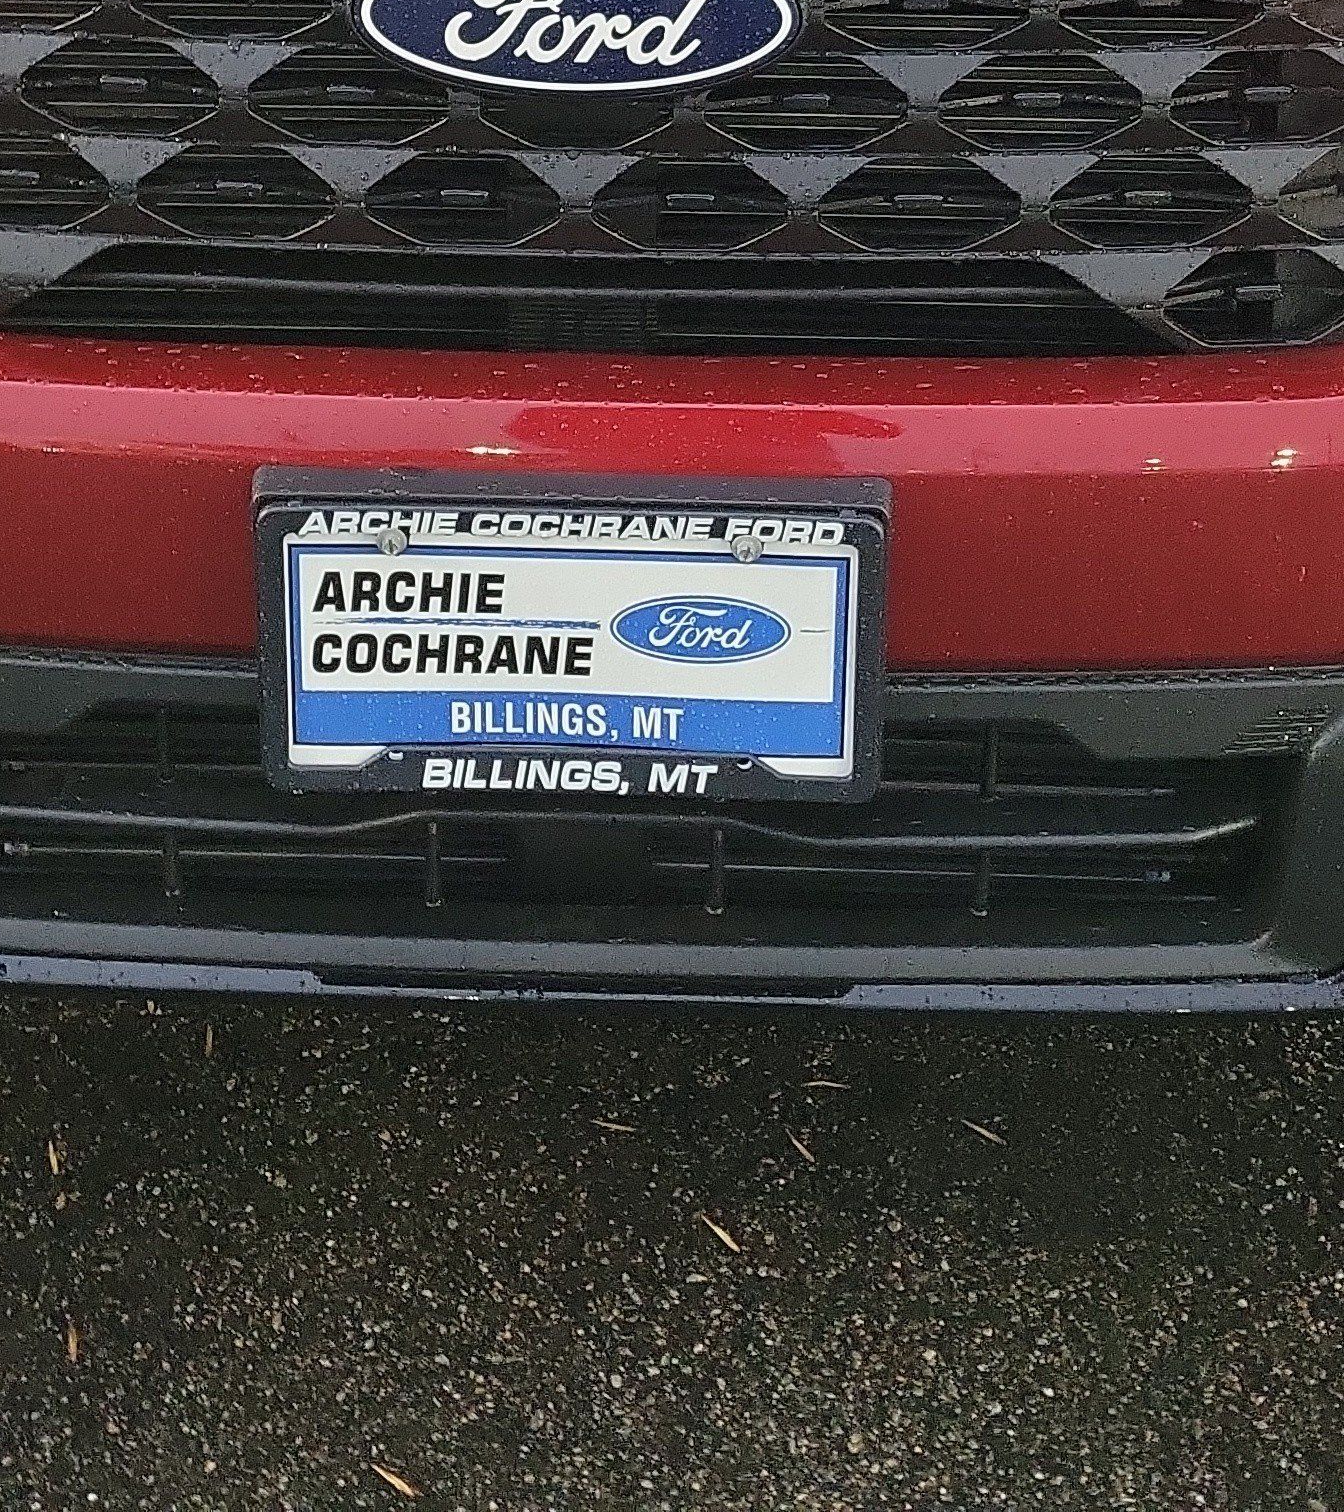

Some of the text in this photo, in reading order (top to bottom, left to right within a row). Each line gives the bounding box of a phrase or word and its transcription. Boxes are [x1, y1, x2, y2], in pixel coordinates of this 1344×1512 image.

[298, 510, 845, 546] ARCHIE COCHRANE FORD
[312, 570, 506, 614] ARCHIE
[648, 605, 753, 649] Ford
[311, 632, 594, 676] COCHRANE
[450, 701, 685, 741] BILLINGS, MT
[421, 758, 719, 796] BILLINGS, MT
